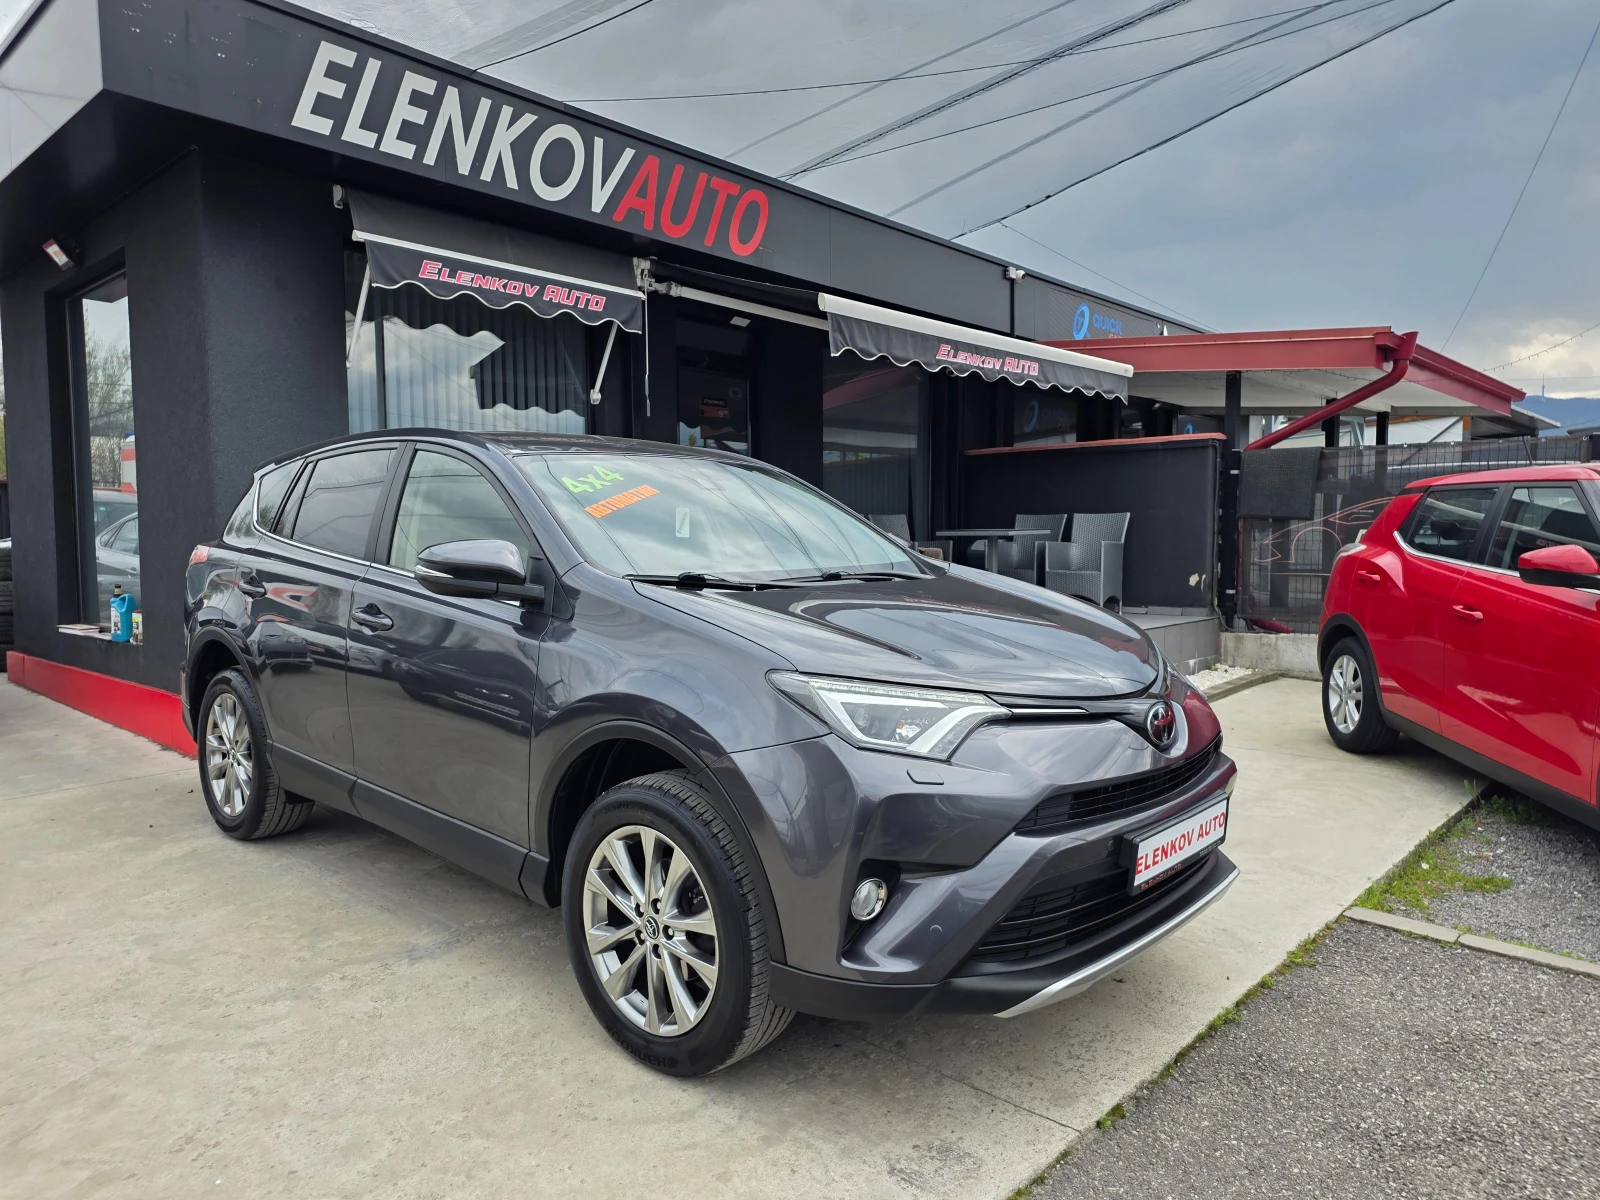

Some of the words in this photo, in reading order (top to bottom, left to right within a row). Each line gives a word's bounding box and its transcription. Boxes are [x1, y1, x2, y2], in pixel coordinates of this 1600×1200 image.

[291, 40, 636, 214] ELENKOV
[612, 154, 769, 257] AUTO
[419, 259, 539, 297] ELENKOV
[542, 284, 606, 312] AUTO
[1092, 313, 1123, 336] QUICK
[936, 343, 1002, 370] ELENKOV
[1003, 357, 1039, 376] AUTO
[1135, 828, 1194, 876] ELENKOV
[1197, 811, 1226, 842] AUTO
